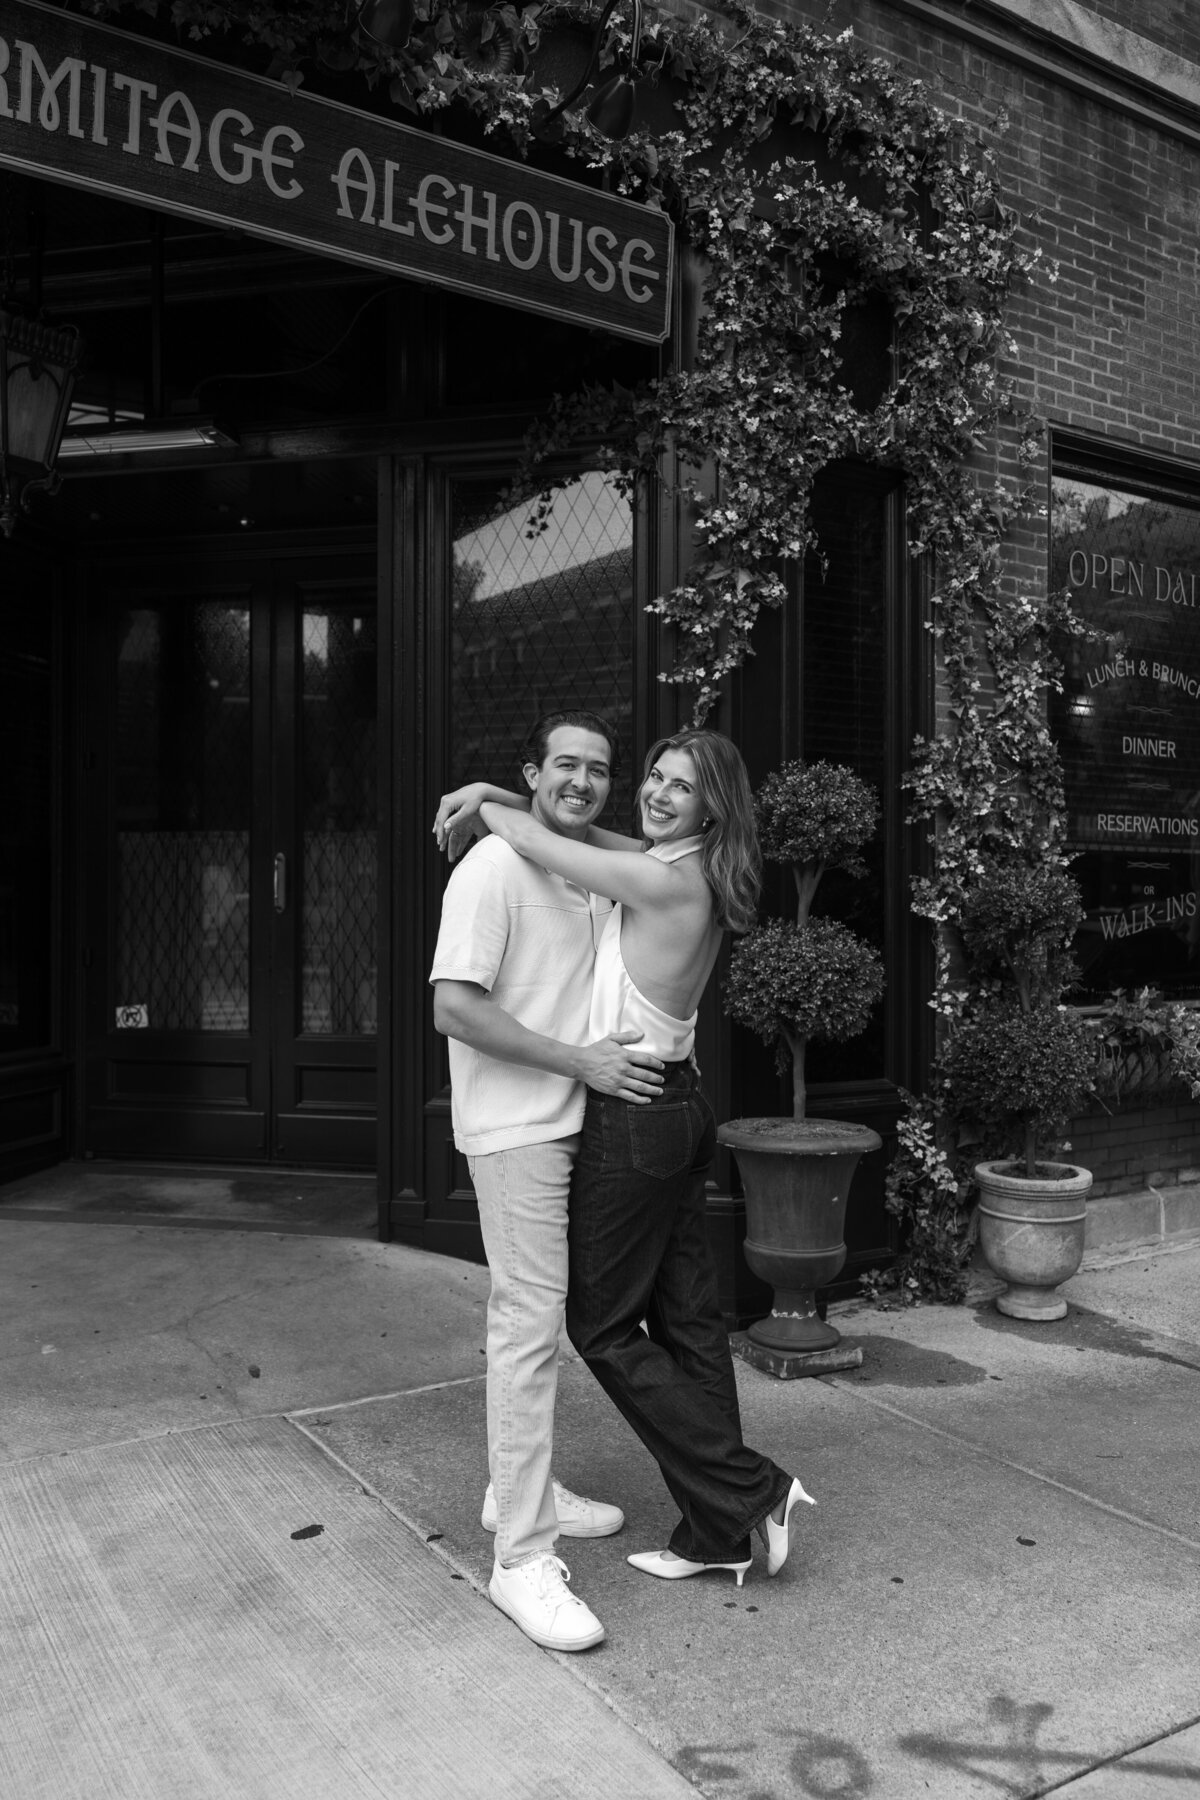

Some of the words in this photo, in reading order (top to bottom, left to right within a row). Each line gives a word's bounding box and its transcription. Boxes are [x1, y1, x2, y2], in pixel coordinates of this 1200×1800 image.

[331, 147, 660, 303] ALEHOUSE
[1069, 550, 1144, 597] OPEN
[1154, 566, 1200, 608] DAI
[1086, 659, 1135, 688] LUNCH
[1138, 659, 1149, 677] &
[1122, 736, 1176, 758] DINNER
[1097, 813, 1199, 836] RESERVATIONS
[1143, 885, 1155, 895] OR
[1099, 892, 1197, 940] WALK-INS
